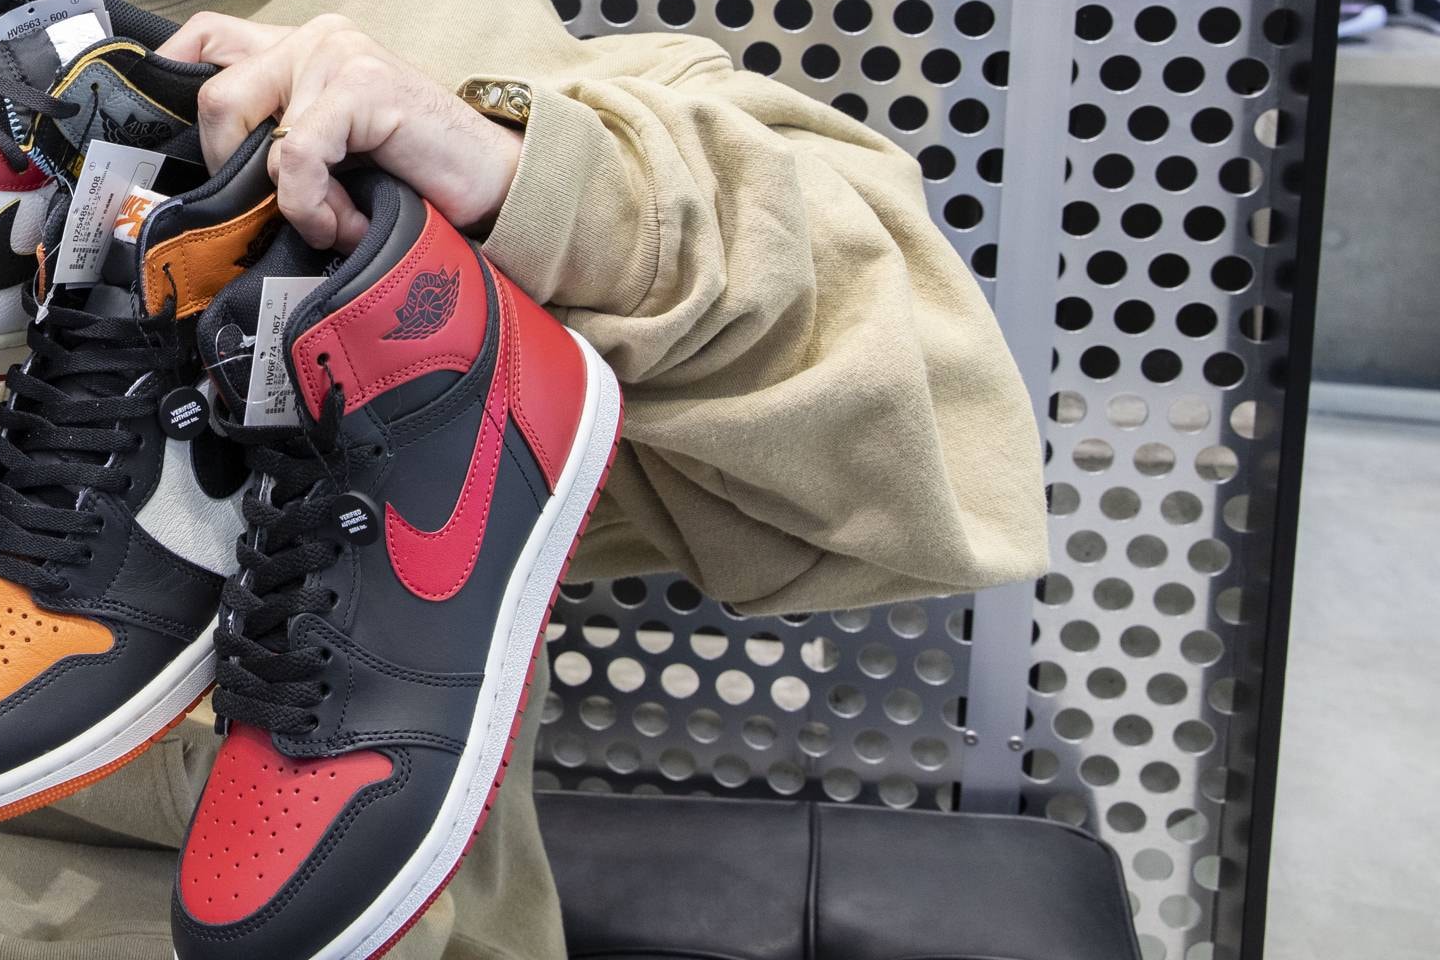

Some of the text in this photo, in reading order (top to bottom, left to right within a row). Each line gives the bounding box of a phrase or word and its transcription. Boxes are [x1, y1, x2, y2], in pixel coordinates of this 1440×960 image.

[7, 18, 41, 39] HV8563
[50, 10, 68, 22] 600
[72, 204, 90, 242] DZ5485
[88, 176, 101, 195] 008
[272, 315, 281, 335] 067
[170, 401, 197, 416] VERIFIED
[171, 405, 202, 424] AUTHENTIC
